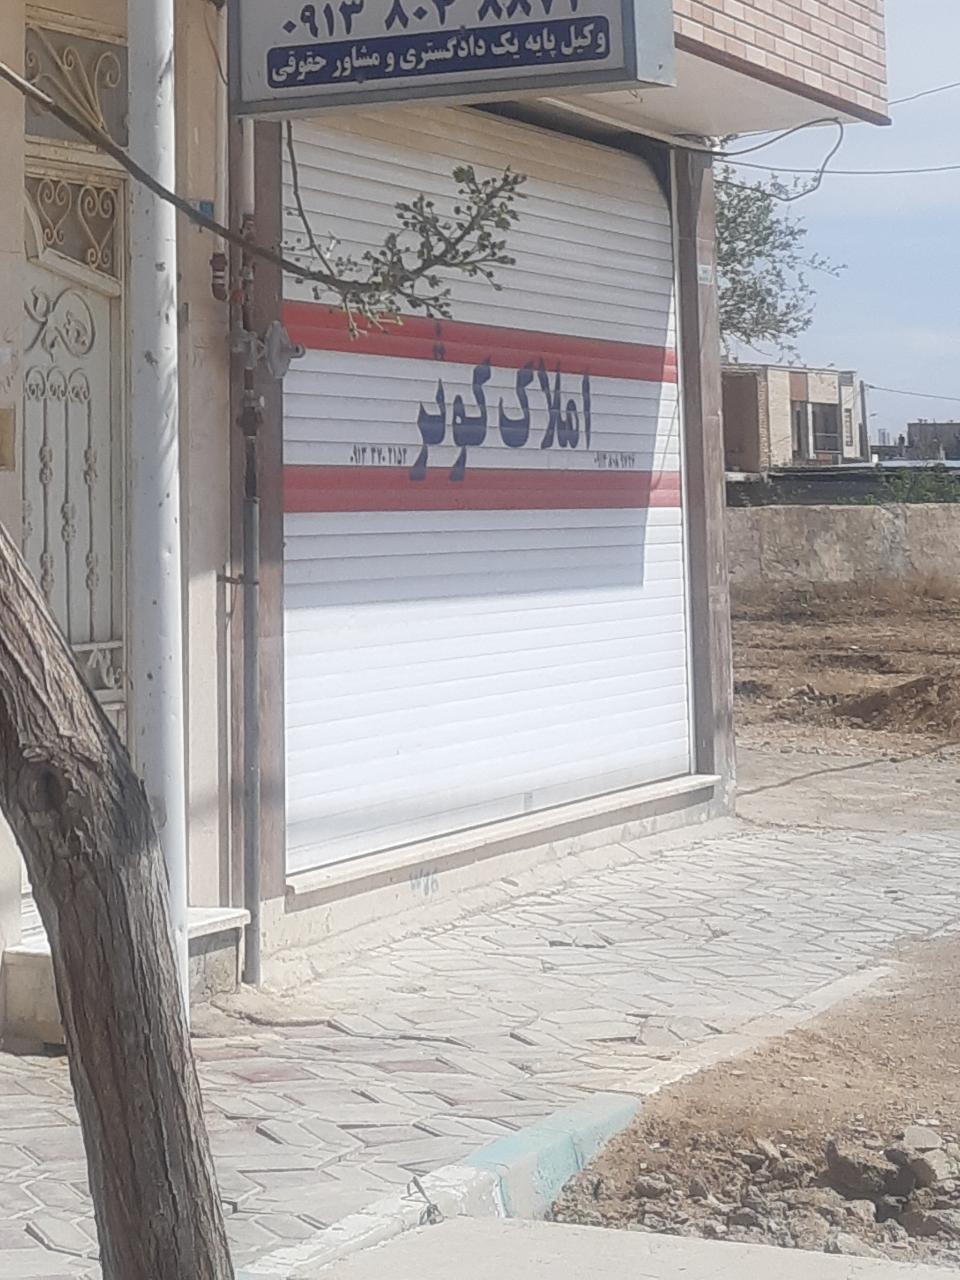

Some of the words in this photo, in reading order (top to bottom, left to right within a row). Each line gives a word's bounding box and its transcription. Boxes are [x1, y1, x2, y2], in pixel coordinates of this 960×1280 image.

[399, 33, 487, 71] دادگستری
[490, 30, 520, 59] یک
[524, 26, 556, 58] پایه
[560, 23, 607, 56] وکیل
[271, 49, 328, 83] حقوقی
[332, 44, 381, 78] مشاور
[384, 50, 396, 73] و
[408, 319, 493, 483] کوثر
[498, 356, 592, 451] املاک
